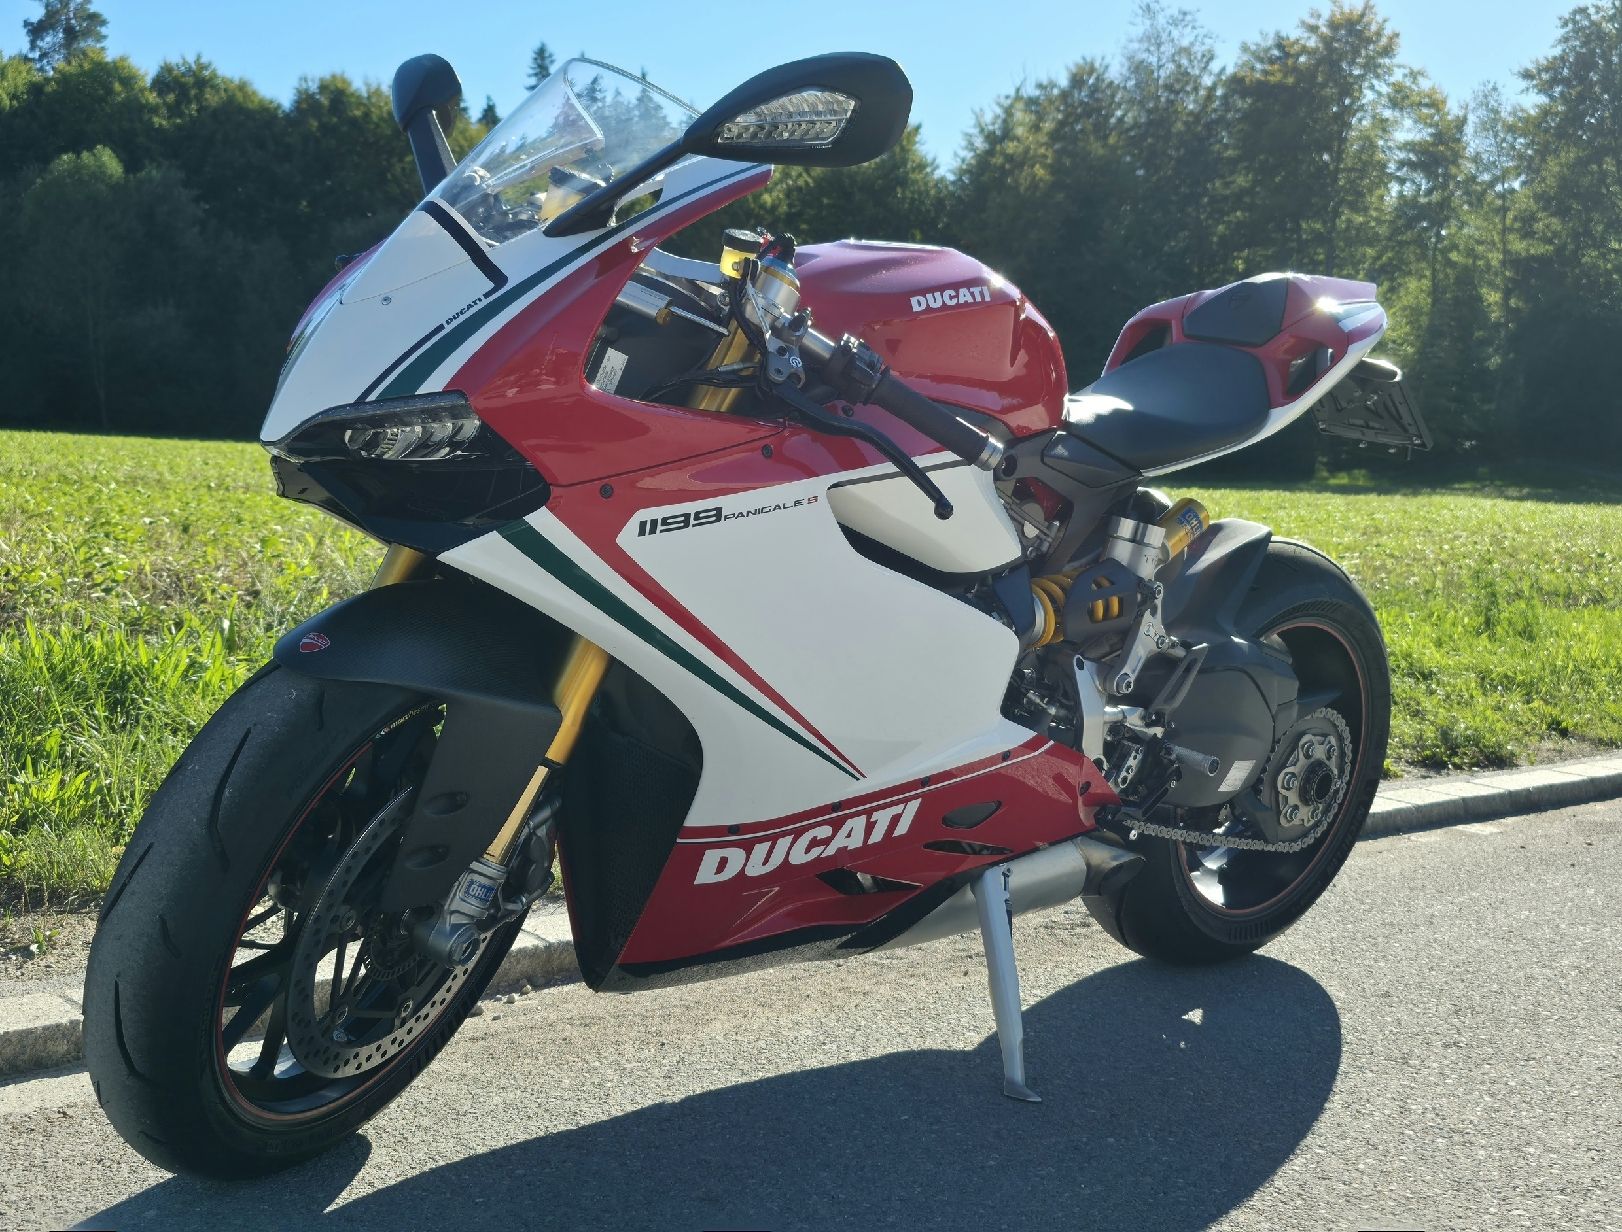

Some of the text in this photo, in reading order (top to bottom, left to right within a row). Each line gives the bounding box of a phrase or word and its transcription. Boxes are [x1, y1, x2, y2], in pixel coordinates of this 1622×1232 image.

[445, 297, 483, 326] DUCATI
[910, 286, 991, 312] DUCATI
[637, 506, 723, 538] 1199
[723, 498, 804, 522] PANIGALE
[693, 798, 922, 886] DUCATI
